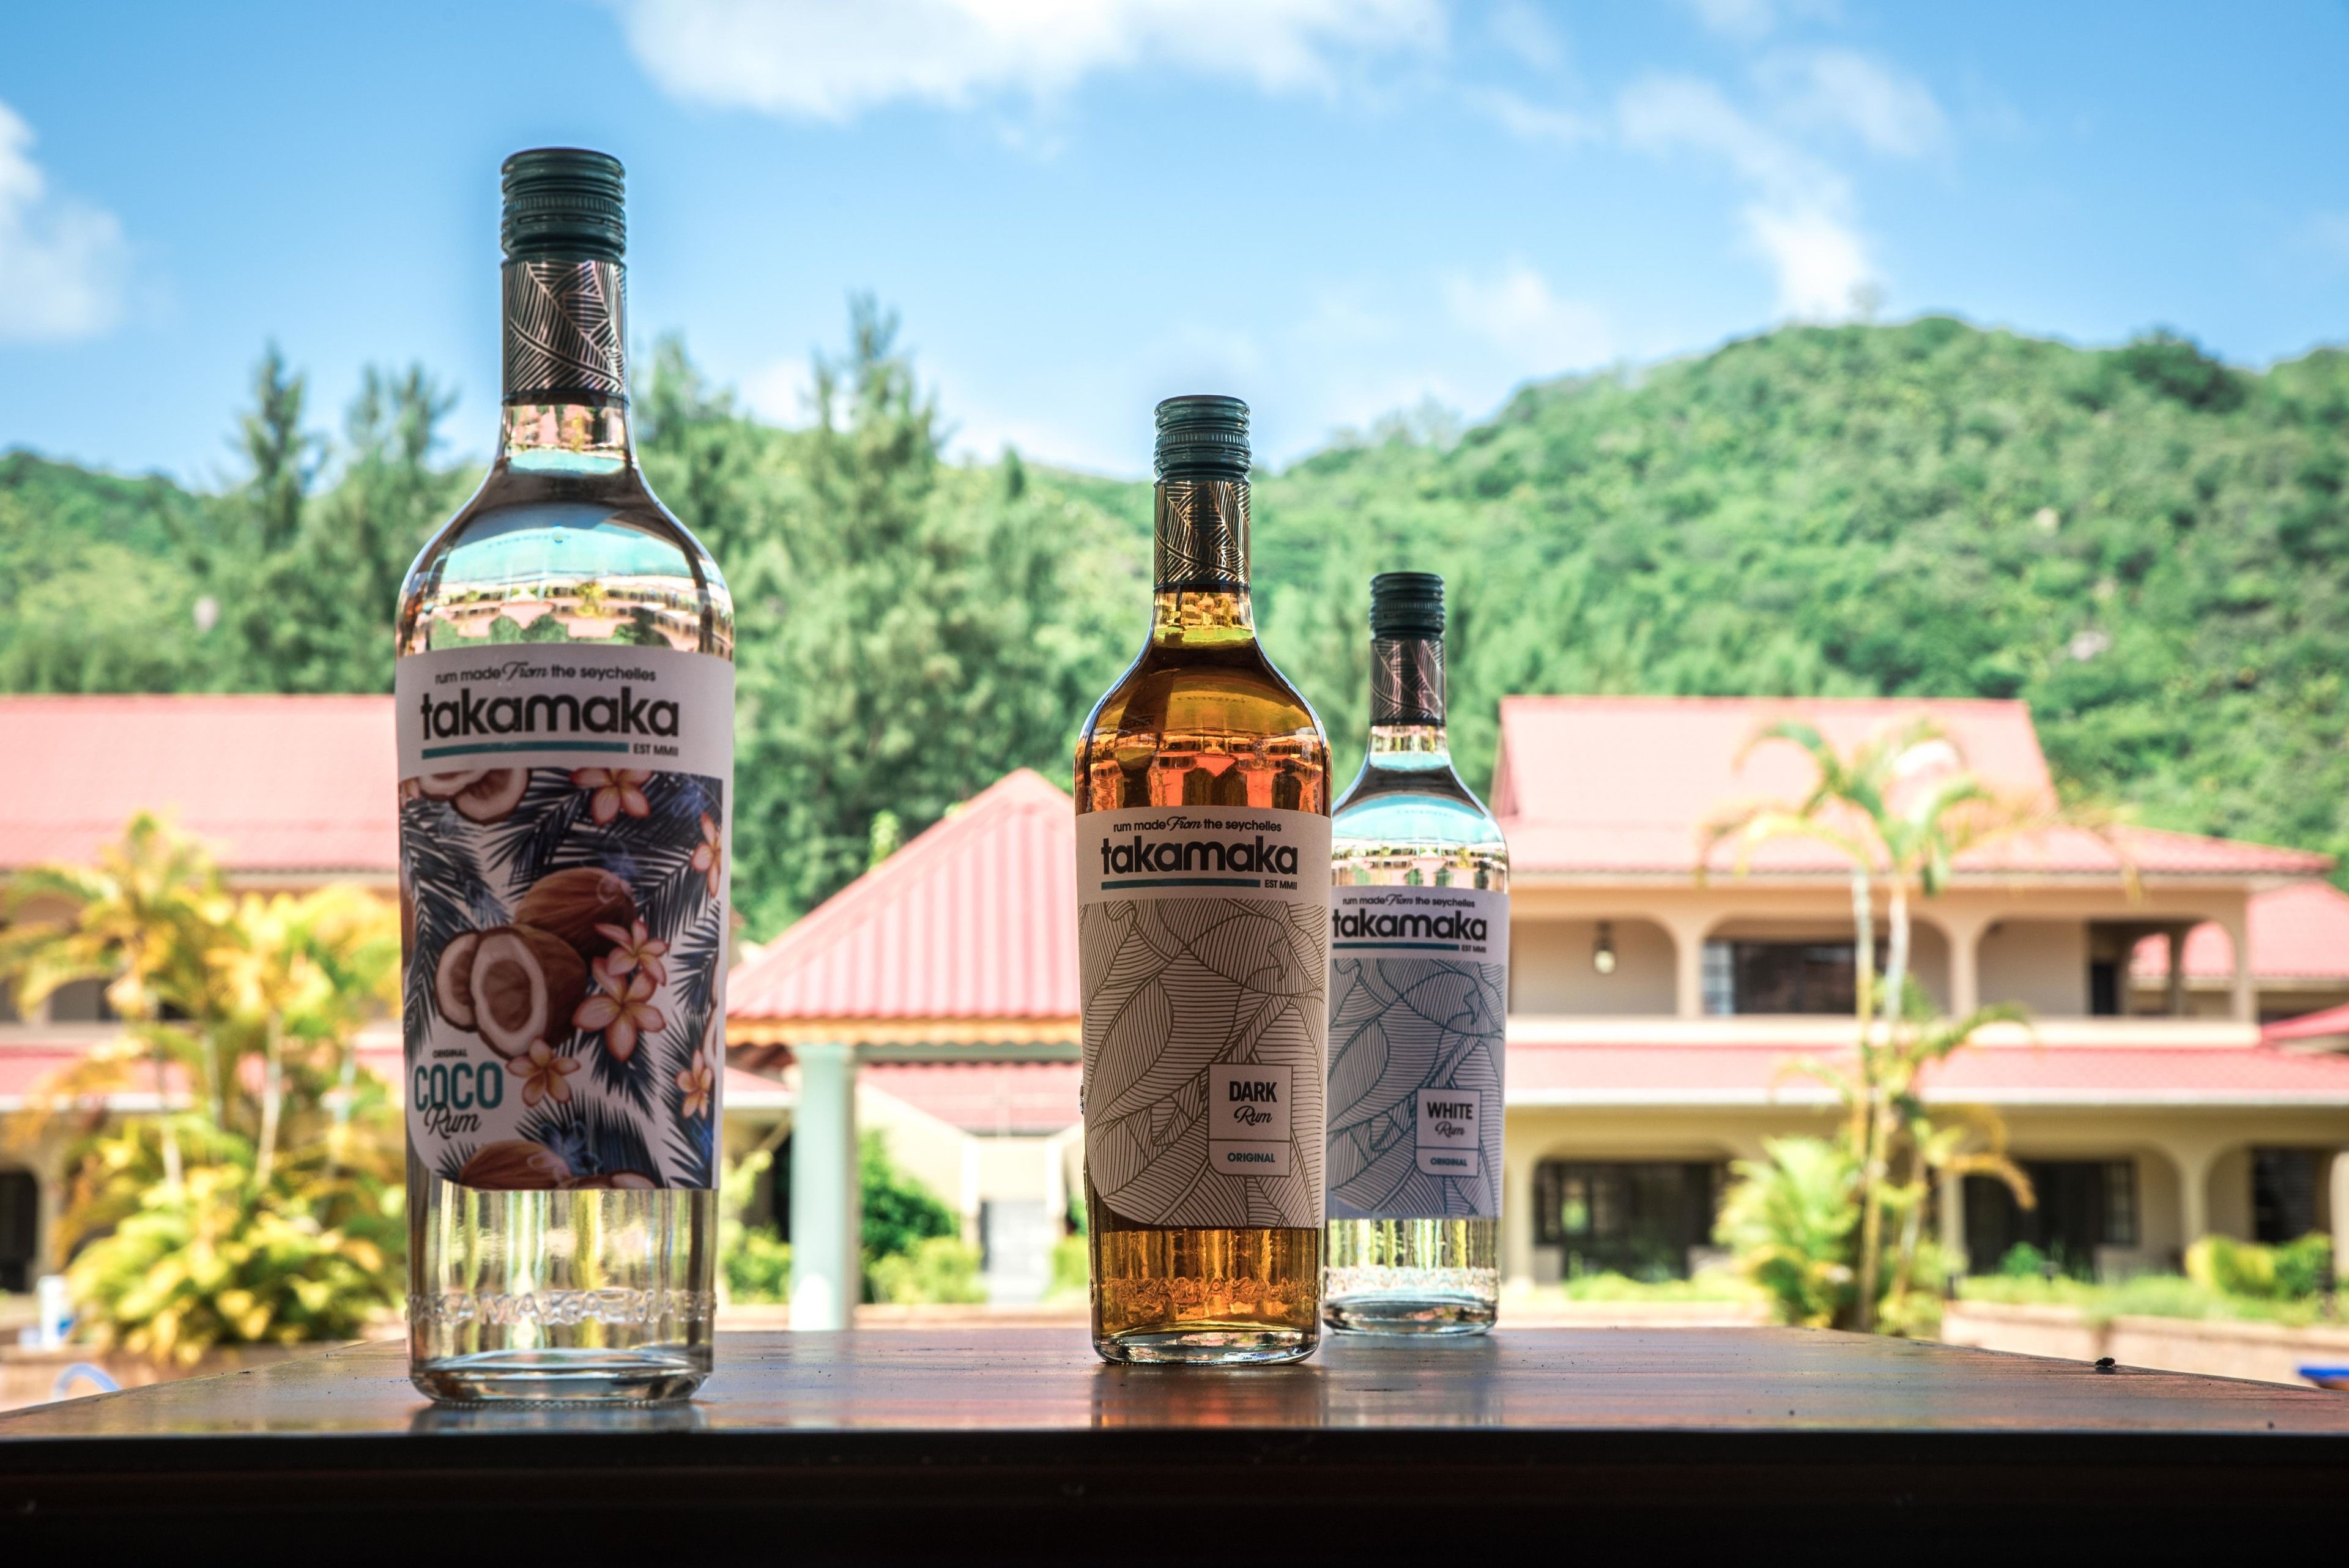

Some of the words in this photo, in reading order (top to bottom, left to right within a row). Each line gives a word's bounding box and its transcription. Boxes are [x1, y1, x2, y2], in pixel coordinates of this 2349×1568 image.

[436, 673, 458, 685] rum
[461, 666, 500, 682] made
[501, 661, 550, 682] From
[551, 664, 576, 679] the
[580, 664, 657, 682] seychelles
[420, 686, 679, 740] takamaka
[633, 743, 652, 756] EST
[1113, 822, 1132, 833] rum
[1134, 819, 1167, 831] made
[1167, 816, 1202, 832] From
[1203, 818, 1223, 830] the
[1225, 819, 1282, 833] seychelles
[1100, 834, 1298, 875] takamaka
[1264, 879, 1278, 889] EST
[1279, 880, 1297, 890] MMII
[1385, 893, 1414, 907] From
[1415, 896, 1430, 905] the
[1432, 897, 1475, 907] seychelles
[1332, 907, 1488, 942] takamaka
[414, 1060, 503, 1112] COCO
[1229, 1080, 1278, 1102] DARK
[1233, 1105, 1273, 1126] Rum
[1427, 1102, 1473, 1120] WHITE
[424, 1102, 482, 1140] Rum
[1434, 1120, 1465, 1138] Rum
[1227, 1152, 1275, 1163] ORIGINAL
[1430, 1157, 1468, 1167] ORIGINAL
